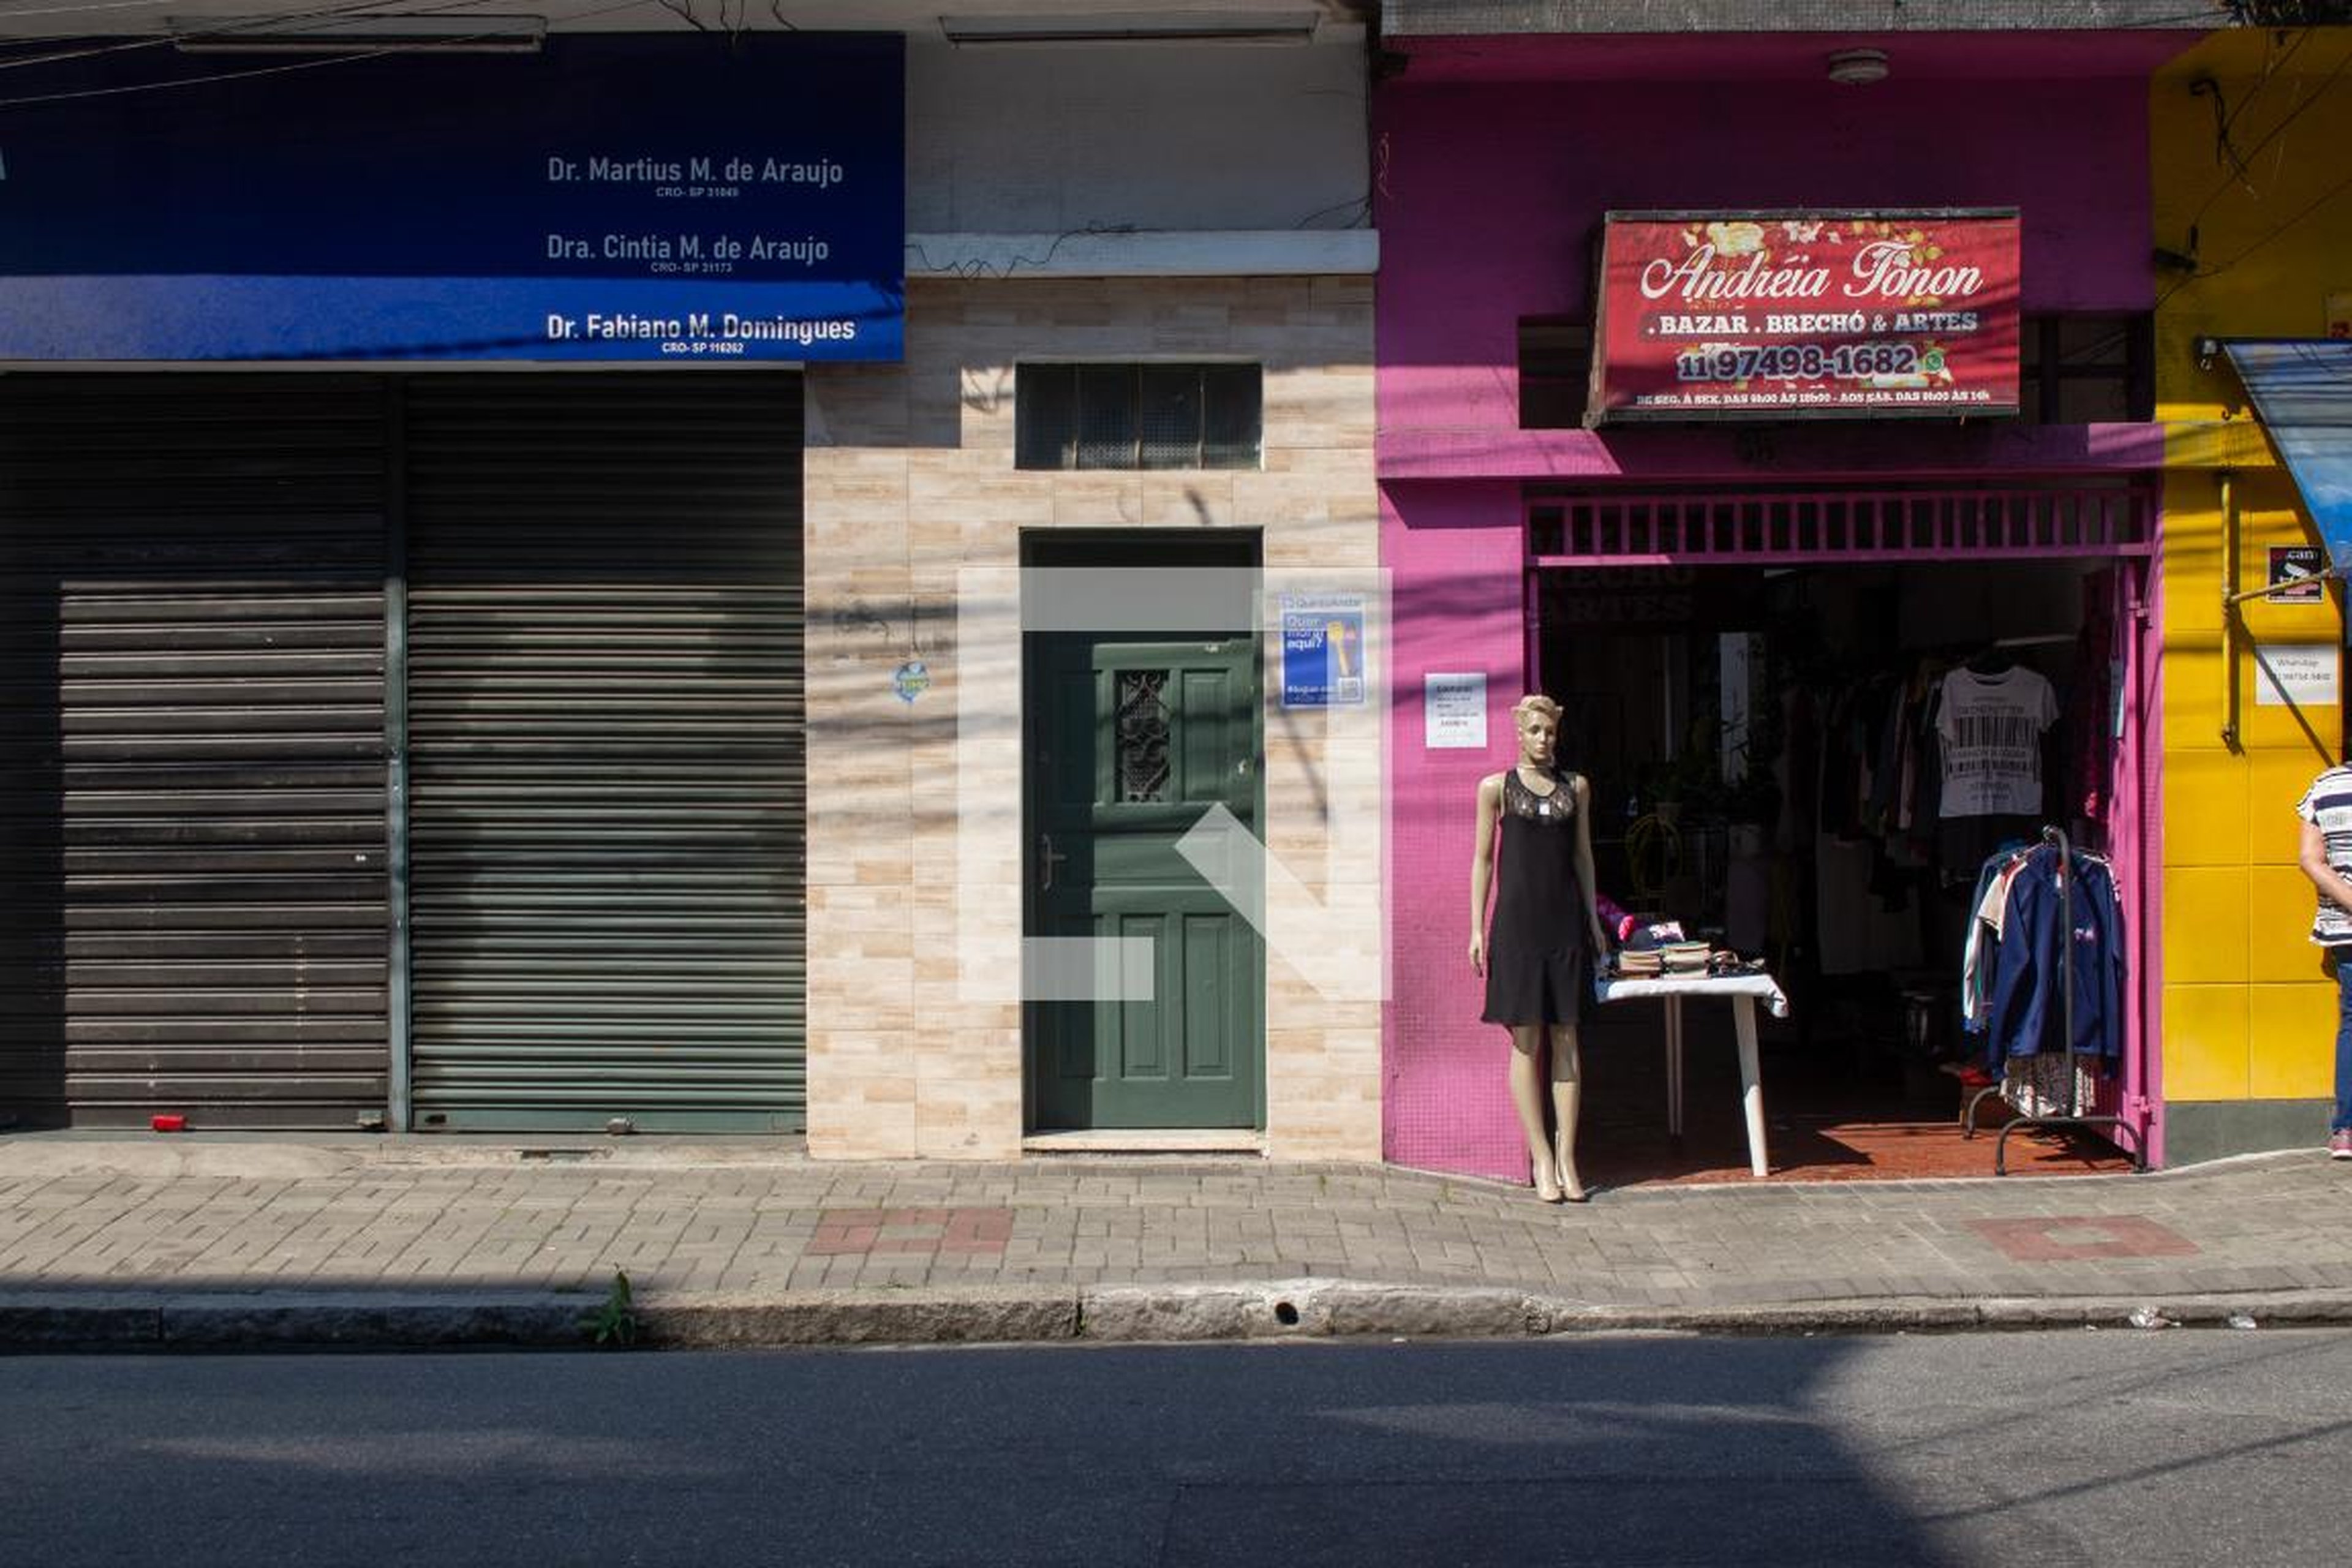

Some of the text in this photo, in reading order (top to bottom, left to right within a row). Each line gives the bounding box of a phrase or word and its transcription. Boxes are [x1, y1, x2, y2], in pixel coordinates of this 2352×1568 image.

[549, 157, 843, 189] Dr. Martius M. de Araujo
[548, 234, 829, 265] Dra. Cintia M. de Araujo
[548, 314, 855, 345] Dr. Fabiano M. Domingues
[1659, 315, 1748, 334] BAZAR
[1765, 311, 1866, 333] BRECHÓ
[1872, 314, 1888, 331] &
[1893, 312, 1978, 333] ARTES
[1714, 345, 1917, 379] 97498-1682
